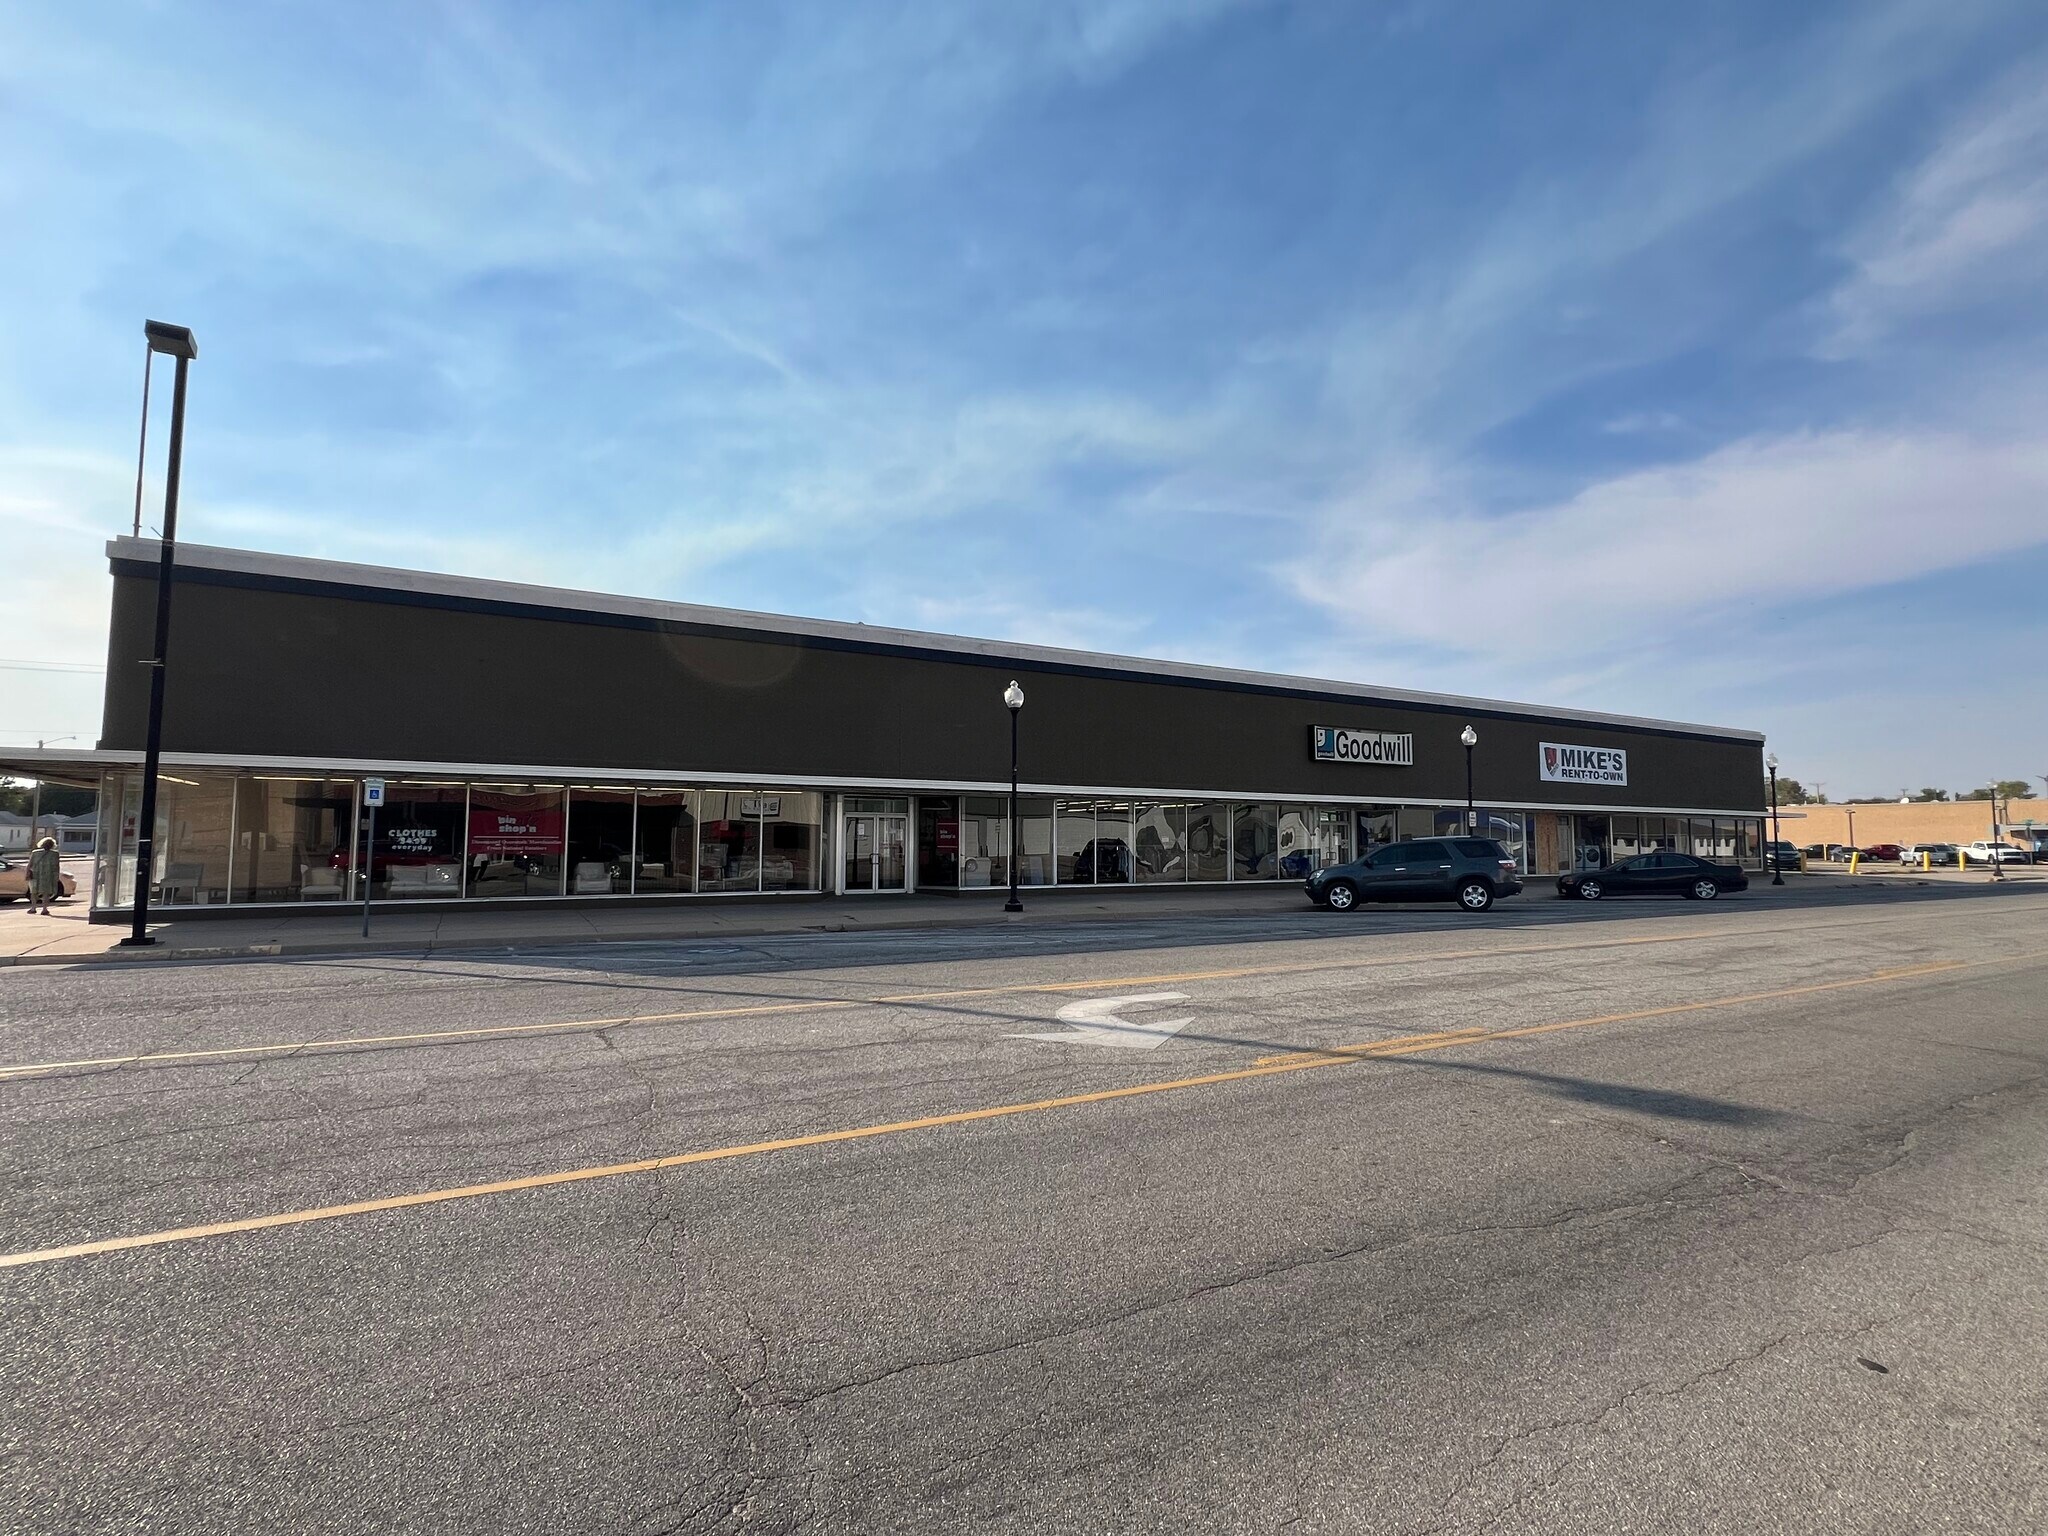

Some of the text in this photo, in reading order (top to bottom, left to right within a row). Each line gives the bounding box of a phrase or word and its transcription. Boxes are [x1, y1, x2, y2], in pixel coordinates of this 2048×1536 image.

[1336, 731, 1411, 762] Goodwill
[1561, 748, 1623, 771] MIKE'S
[1562, 769, 1623, 781] RENT-TO-OWN
[388, 829, 437, 837] CLOTHES
